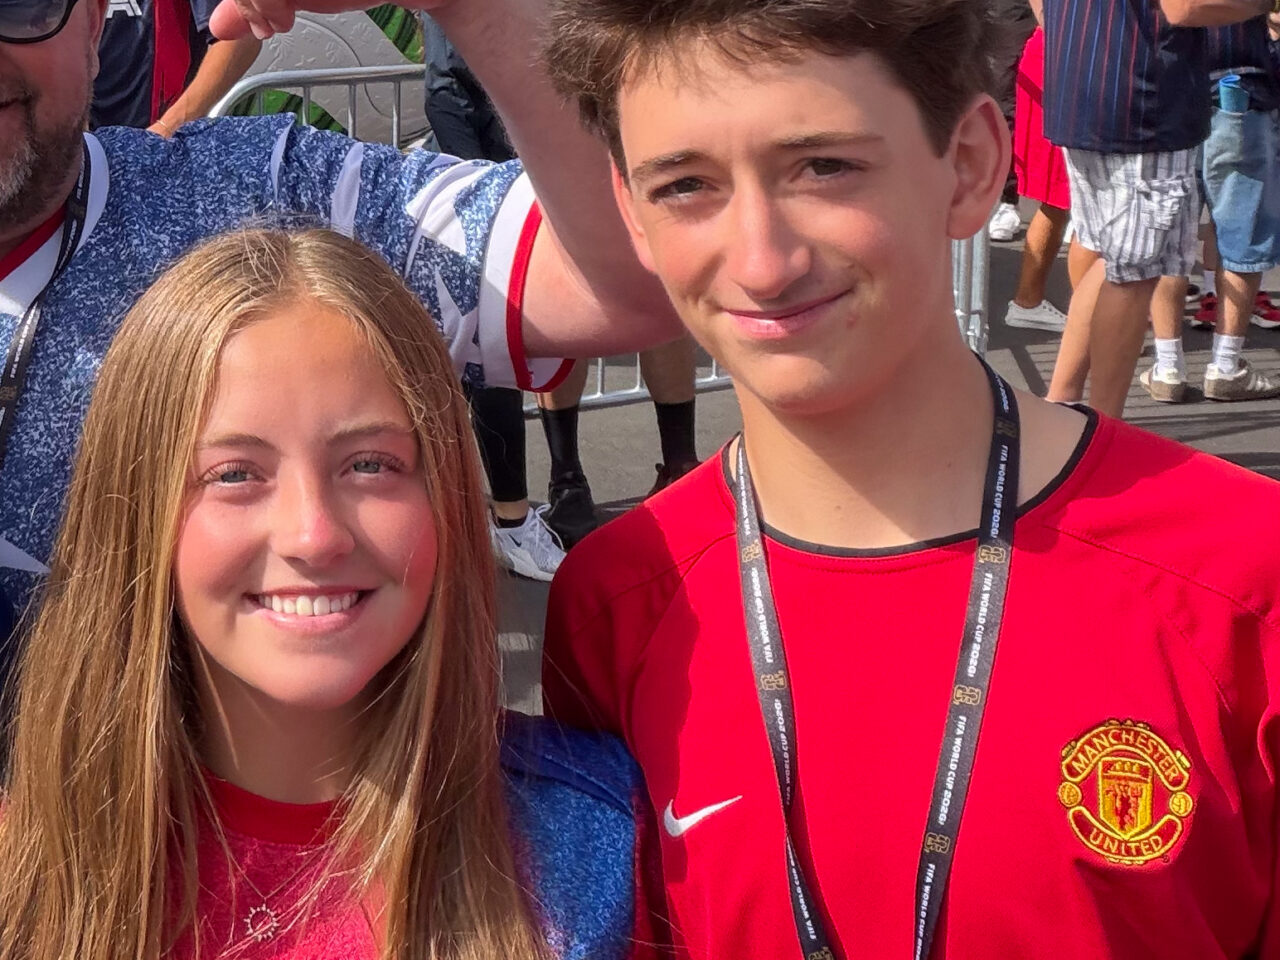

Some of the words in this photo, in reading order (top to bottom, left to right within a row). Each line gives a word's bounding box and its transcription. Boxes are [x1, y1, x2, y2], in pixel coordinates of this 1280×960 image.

[982, 572, 993, 591] FIFA
[976, 592, 991, 625] WORLD
[975, 624, 985, 643] CUP
[956, 715, 967, 736] FIFA
[950, 737, 963, 771] WORLD
[1072, 729, 1180, 781] MANCHESTER
[945, 771, 956, 791] CUP
[1089, 828, 1164, 856] UNITED
[925, 863, 936, 883] FIFA
